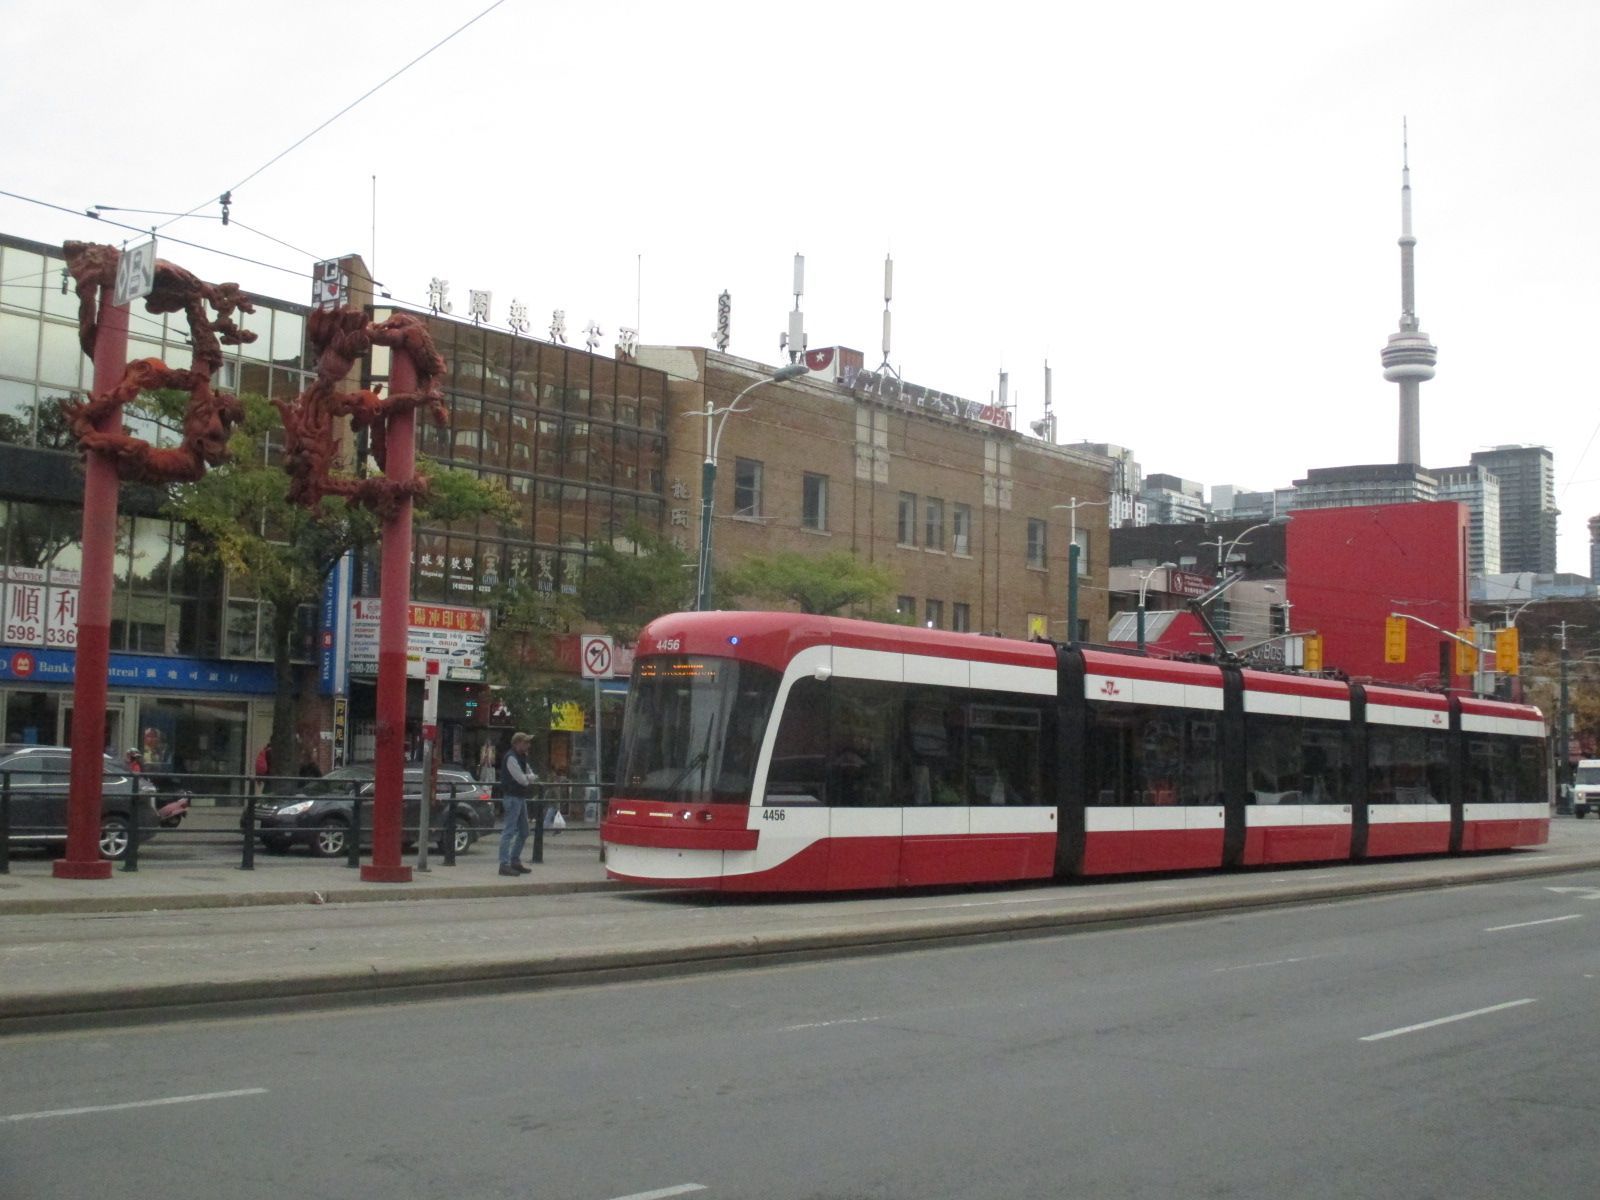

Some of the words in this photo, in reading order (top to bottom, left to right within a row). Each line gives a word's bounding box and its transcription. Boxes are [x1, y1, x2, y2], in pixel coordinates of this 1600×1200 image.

[325, 599, 333, 628] Bank
[353, 601, 362, 619] 1
[656, 639, 680, 650] 4456
[39, 661, 69, 673] Bank
[108, 666, 138, 678] treal
[763, 810, 786, 821] 4456
